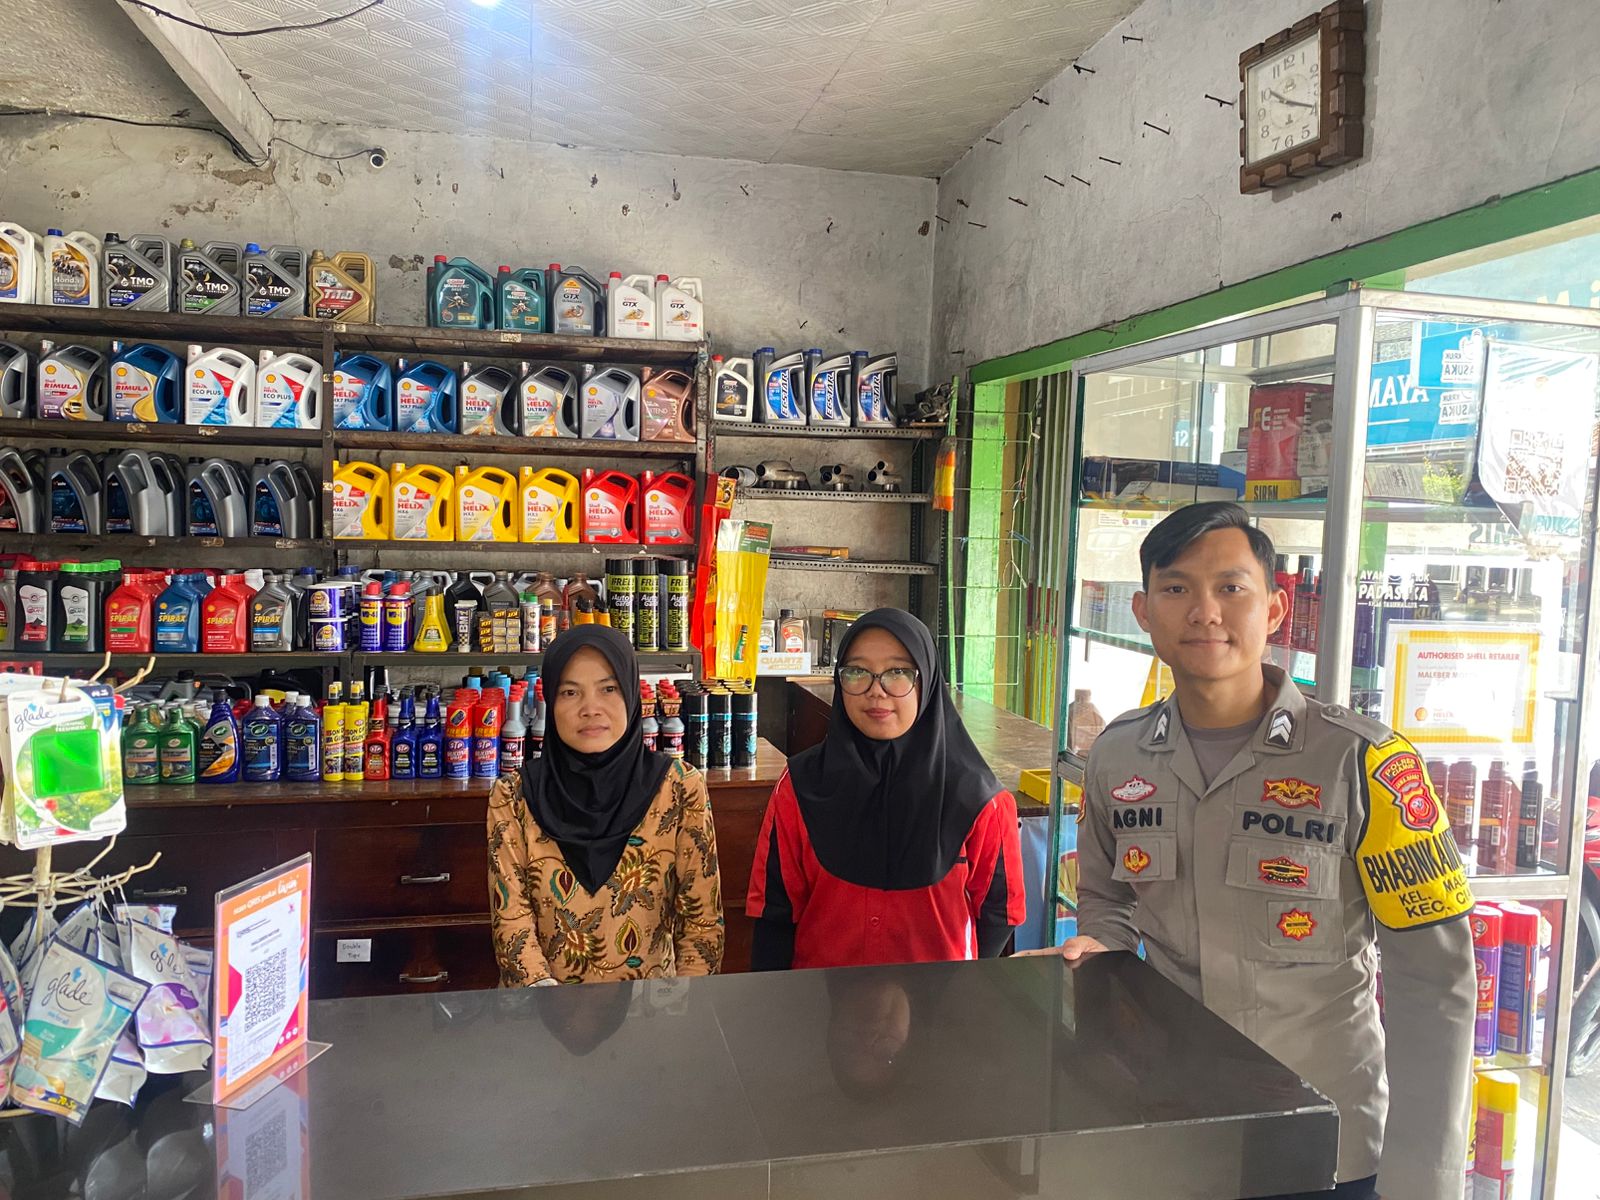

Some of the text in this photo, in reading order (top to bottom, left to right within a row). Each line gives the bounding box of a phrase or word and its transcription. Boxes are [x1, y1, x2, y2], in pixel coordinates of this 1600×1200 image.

[130, 277, 154, 286] TMO
[205, 282, 228, 290] TMO
[268, 286, 290, 294] TMO
[110, 614, 138, 622] SPIRAX
[1417, 652, 1464, 660] AUTHORISED
[15, 706, 56, 732] glade
[449, 741, 464, 749] STP
[477, 741, 492, 749] STP
[1385, 758, 1415, 776] POLRES
[1114, 807, 1162, 828] AGNI
[1243, 810, 1336, 844] POLRI
[1399, 875, 1467, 908] KEL. MAL
[1405, 900, 1450, 920] KEC.
[42, 976, 94, 1007] glade
